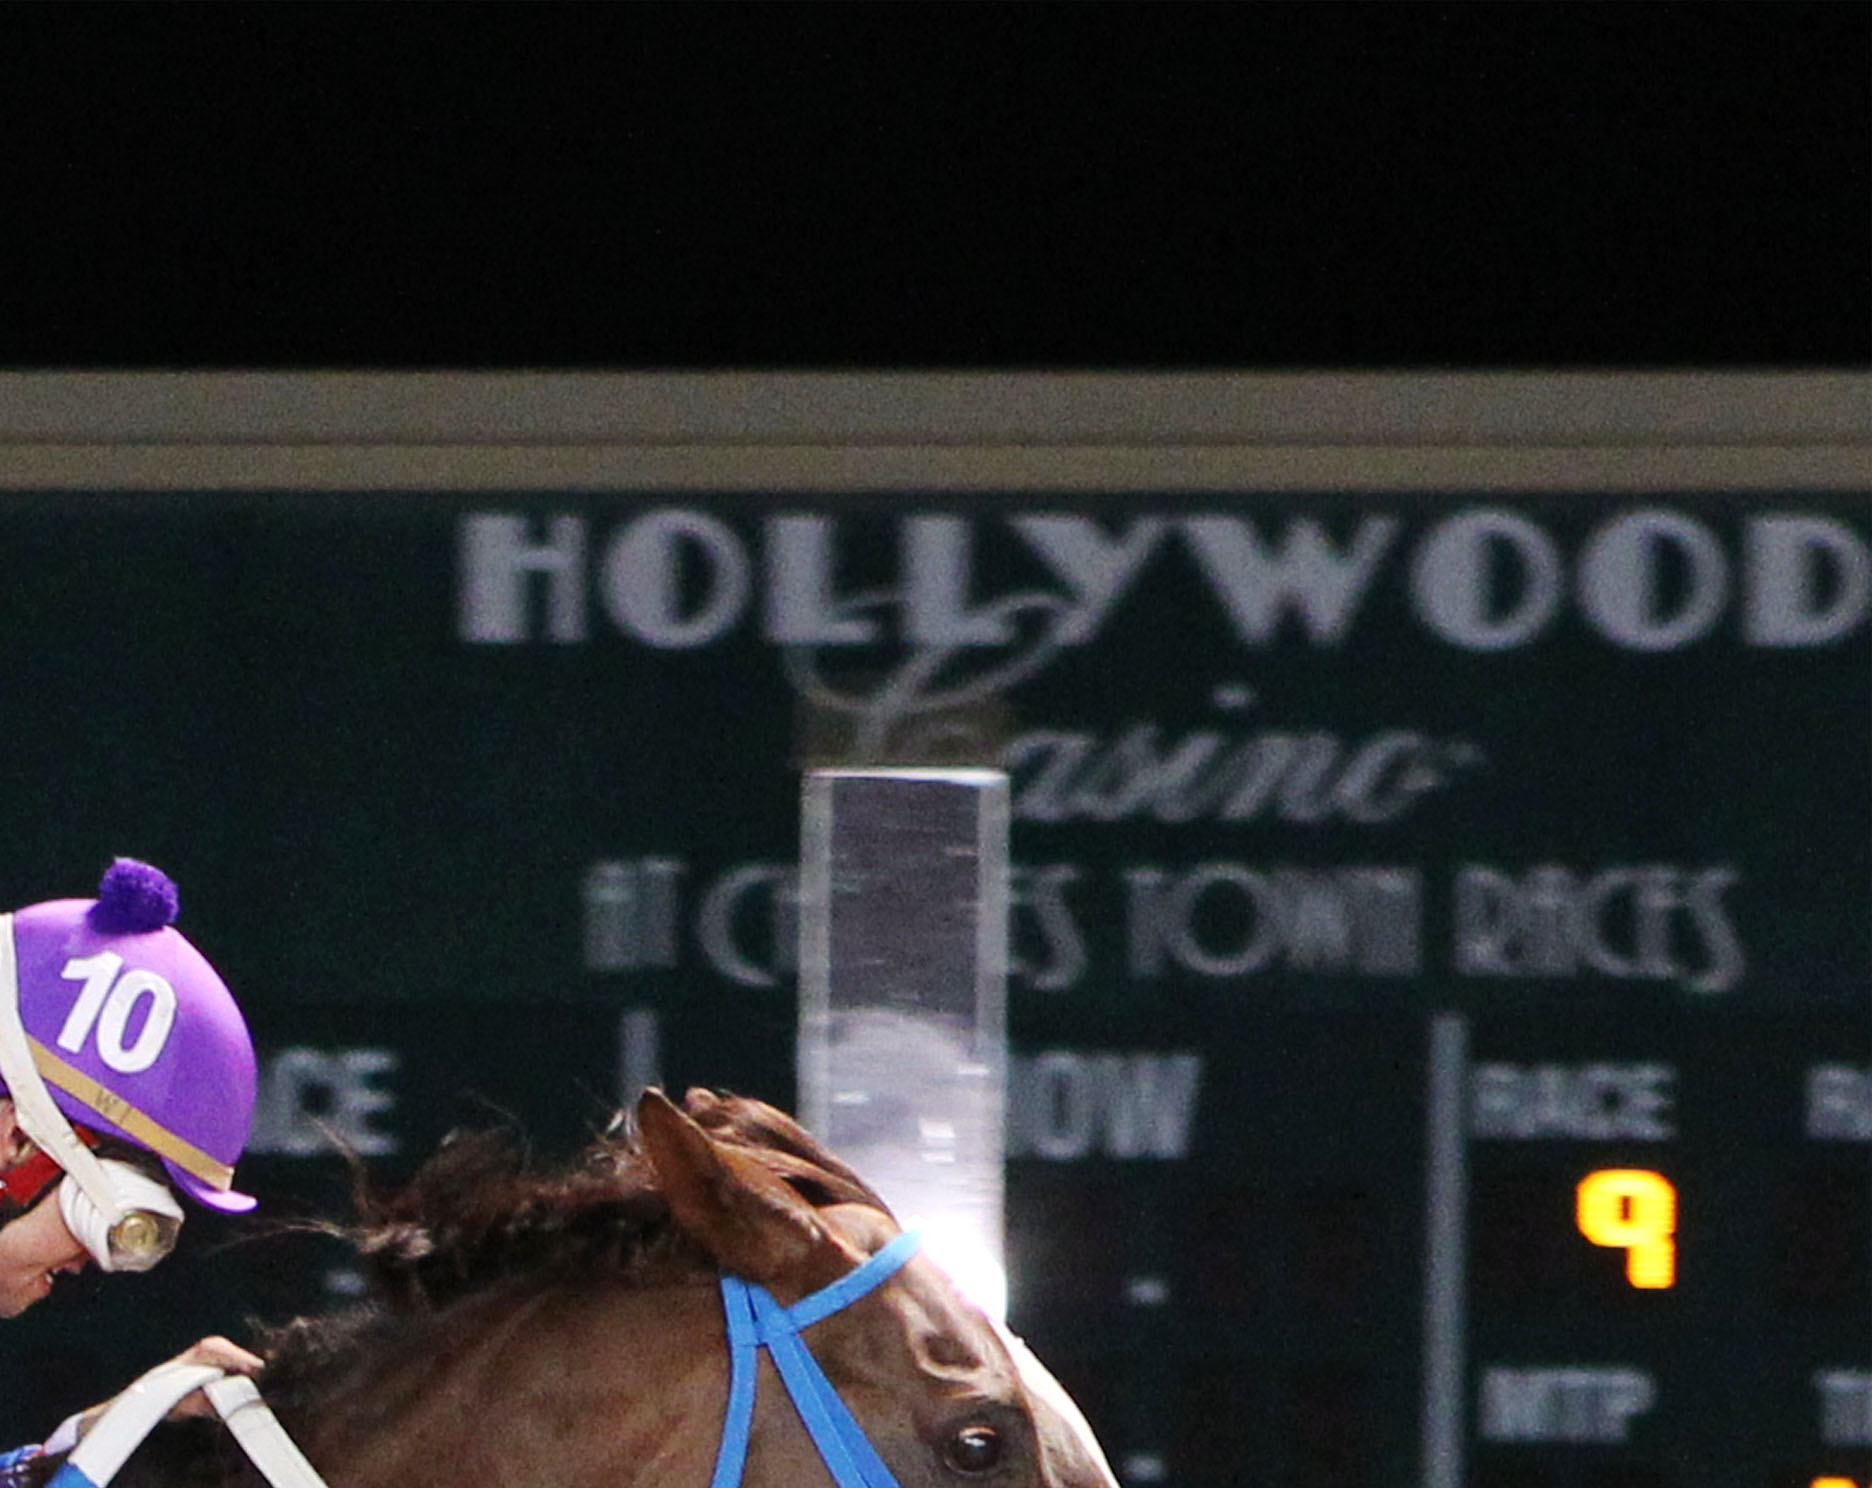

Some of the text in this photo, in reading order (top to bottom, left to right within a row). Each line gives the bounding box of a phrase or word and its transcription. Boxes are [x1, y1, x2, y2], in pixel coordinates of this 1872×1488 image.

[460, 508, 1872, 648] HOLLYWOOD
[56, 950, 178, 1074] 10
[1473, 1064, 1676, 1140] RACE
[1578, 1168, 1676, 1288] 9
